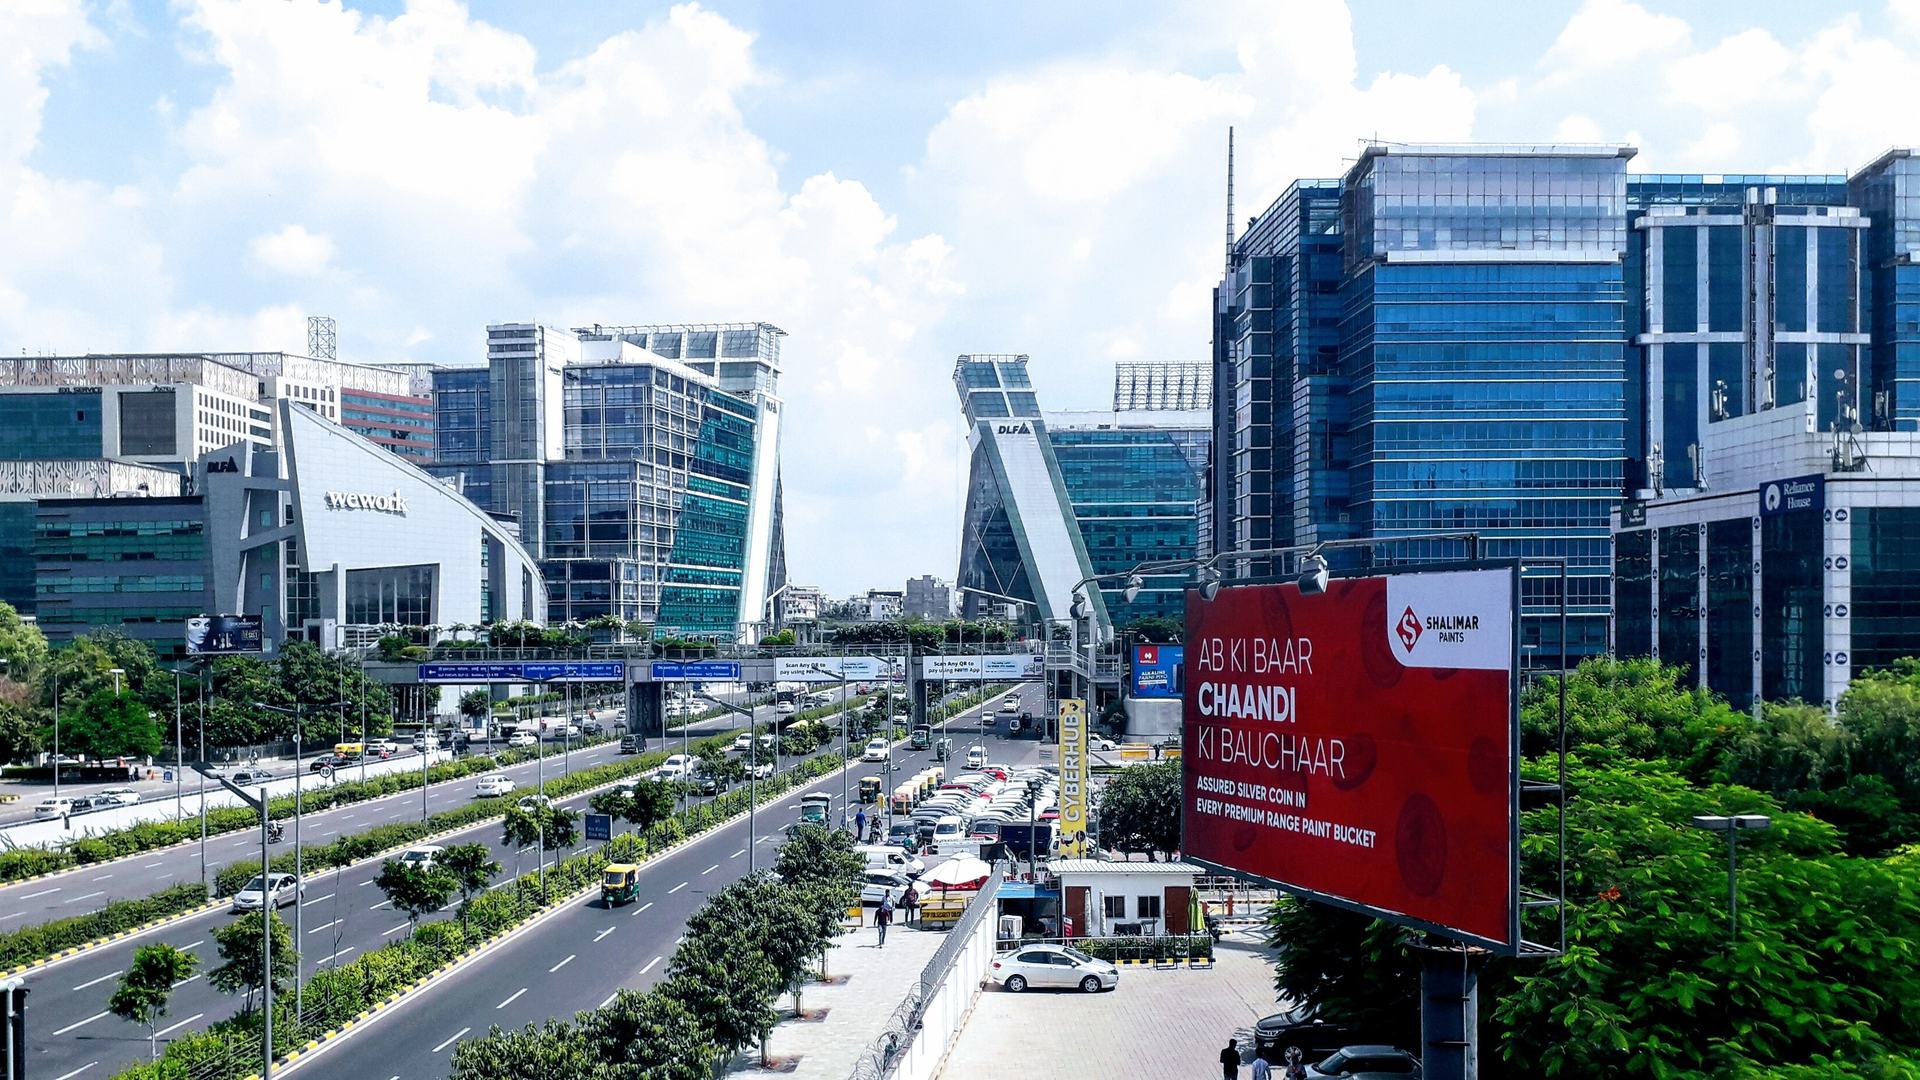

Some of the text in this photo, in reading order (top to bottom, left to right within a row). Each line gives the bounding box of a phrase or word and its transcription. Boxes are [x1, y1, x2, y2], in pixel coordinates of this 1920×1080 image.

[999, 426, 1019, 434] DLF
[327, 488, 409, 514] wework
[1783, 481, 1816, 495] Reliance
[1787, 497, 1811, 509] House
[1426, 615, 1479, 630] SHALIMAR
[1439, 632, 1465, 643] PAINTS
[799, 662, 810, 670] Any
[1198, 638, 1312, 675] AB KI BAAR
[1198, 681, 1296, 724] CHAANDI
[1198, 725, 1345, 779] KI BAUCHAAR
[1063, 714, 1081, 823] CYBERHUB
[1197, 776, 1306, 809] ASSURED SILVER COIN IN
[1197, 798, 1377, 849] EVERY PREMIUM RANGE PAINT BUCKET
